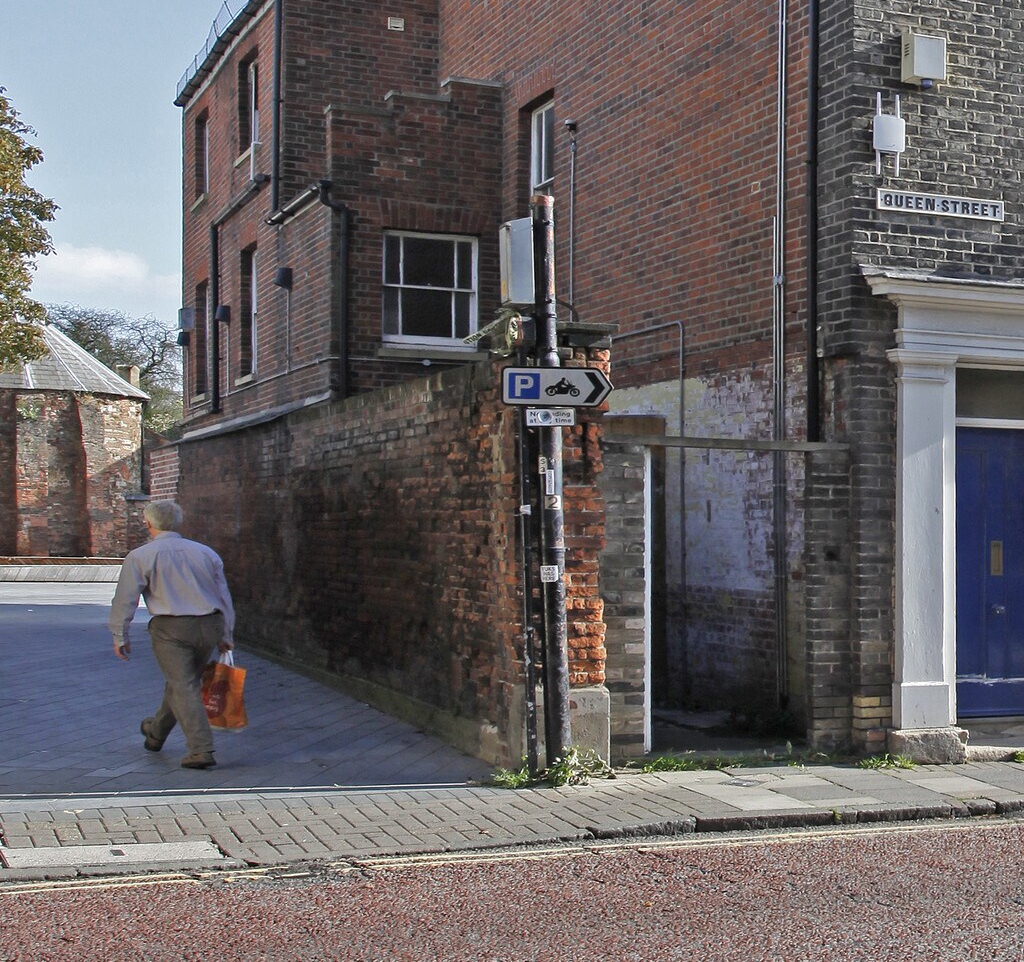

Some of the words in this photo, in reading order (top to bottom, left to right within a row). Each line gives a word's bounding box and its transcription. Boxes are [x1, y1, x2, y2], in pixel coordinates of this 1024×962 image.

[884, 193, 936, 211] QUEEN
[942, 200, 999, 217] STREET
[514, 375, 534, 397] P
[549, 496, 558, 509] 2
